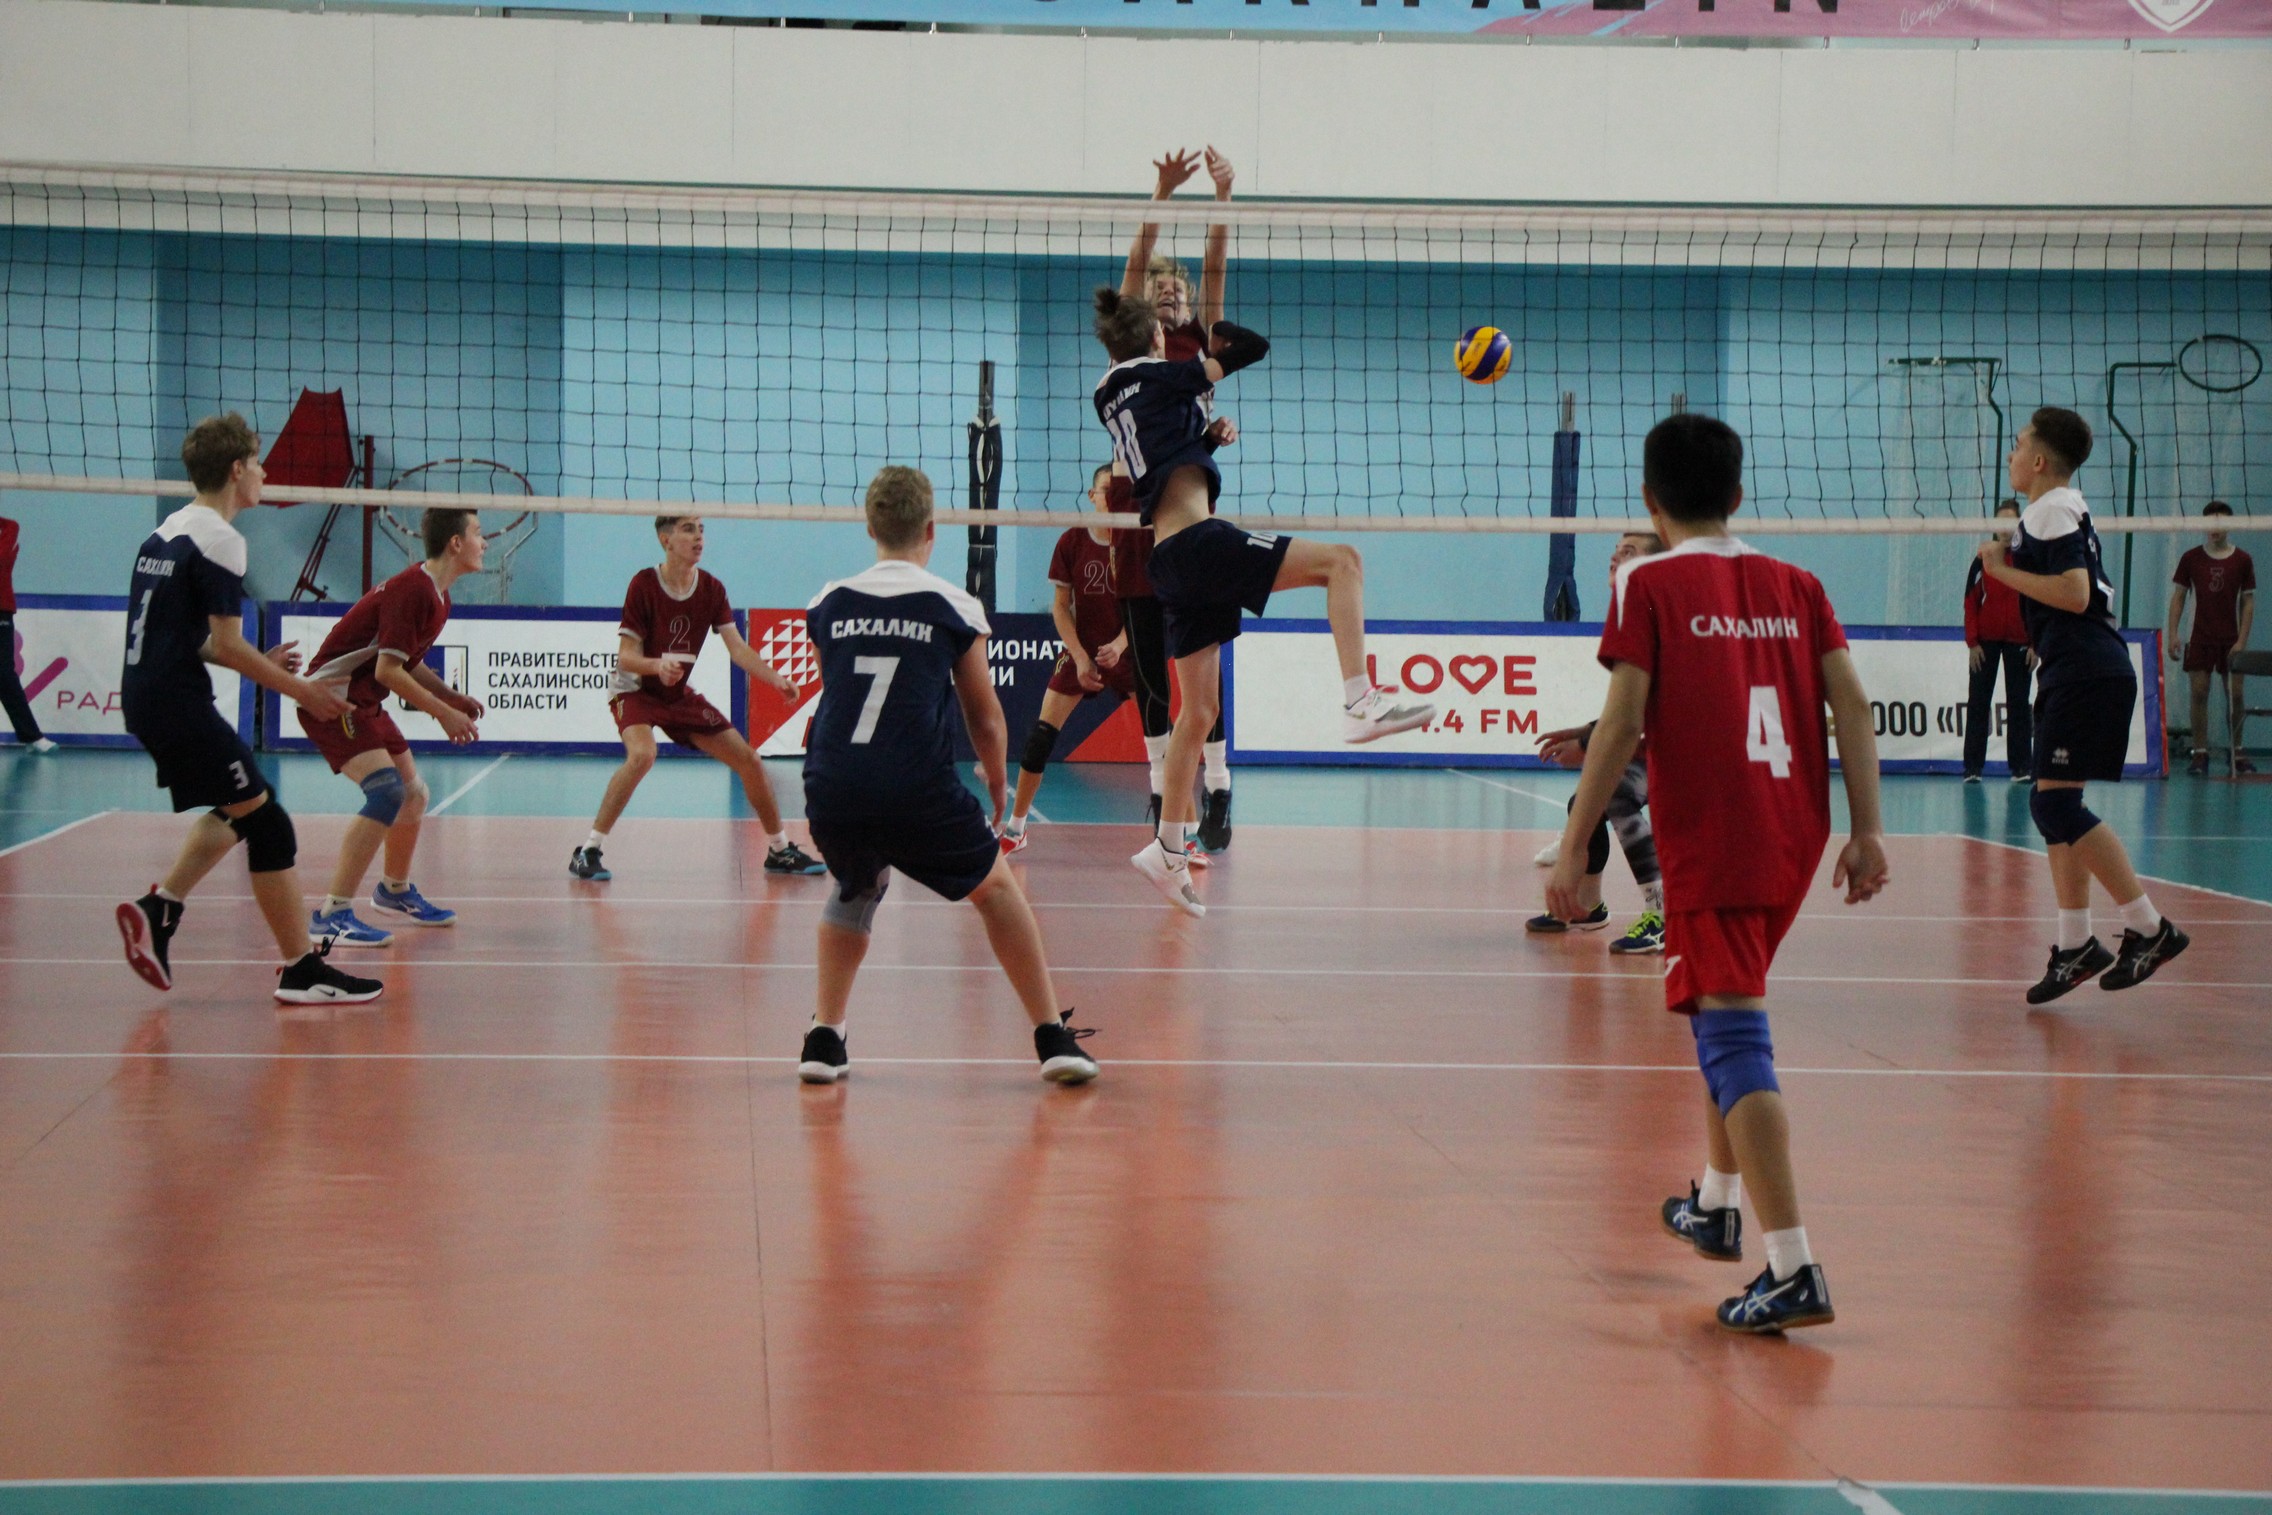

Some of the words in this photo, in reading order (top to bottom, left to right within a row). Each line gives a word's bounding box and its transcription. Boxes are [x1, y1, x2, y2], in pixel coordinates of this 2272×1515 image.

[668, 614, 691, 653] 2
[831, 618, 933, 643] САХАЛИН
[1690, 615, 1799, 639] САХАЛИН
[488, 693, 568, 710] ОБЛАСТИ
[850, 655, 900, 744] 7
[1480, 709, 1538, 735] FM
[1746, 685, 1793, 778] 4
[229, 760, 249, 790] 3
